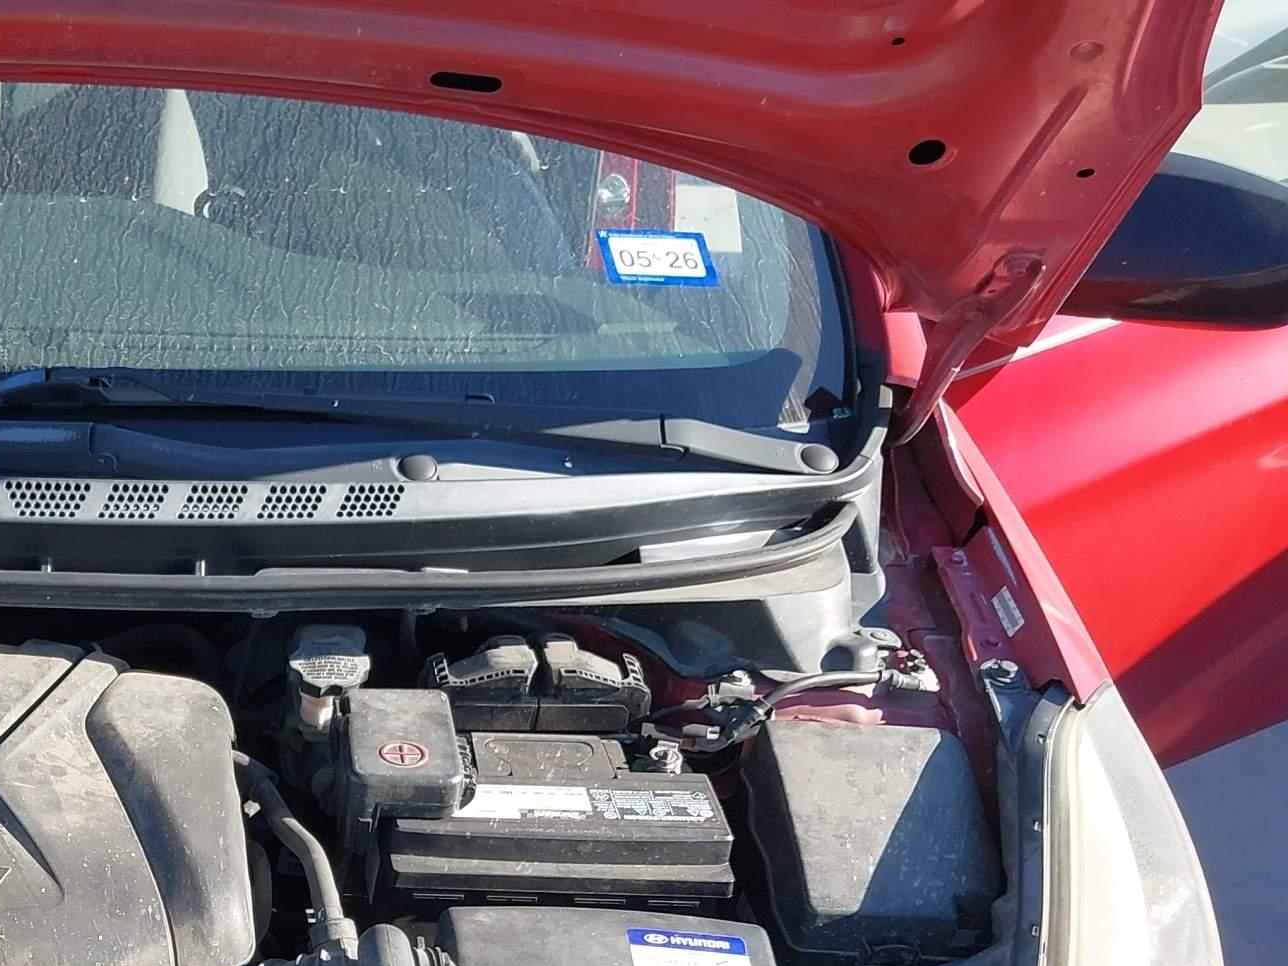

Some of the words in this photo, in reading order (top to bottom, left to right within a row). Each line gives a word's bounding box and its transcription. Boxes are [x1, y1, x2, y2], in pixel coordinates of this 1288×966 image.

[619, 249, 652, 269] 05
[665, 251, 699, 270] 26
[670, 935, 731, 950] HYUNDAI
